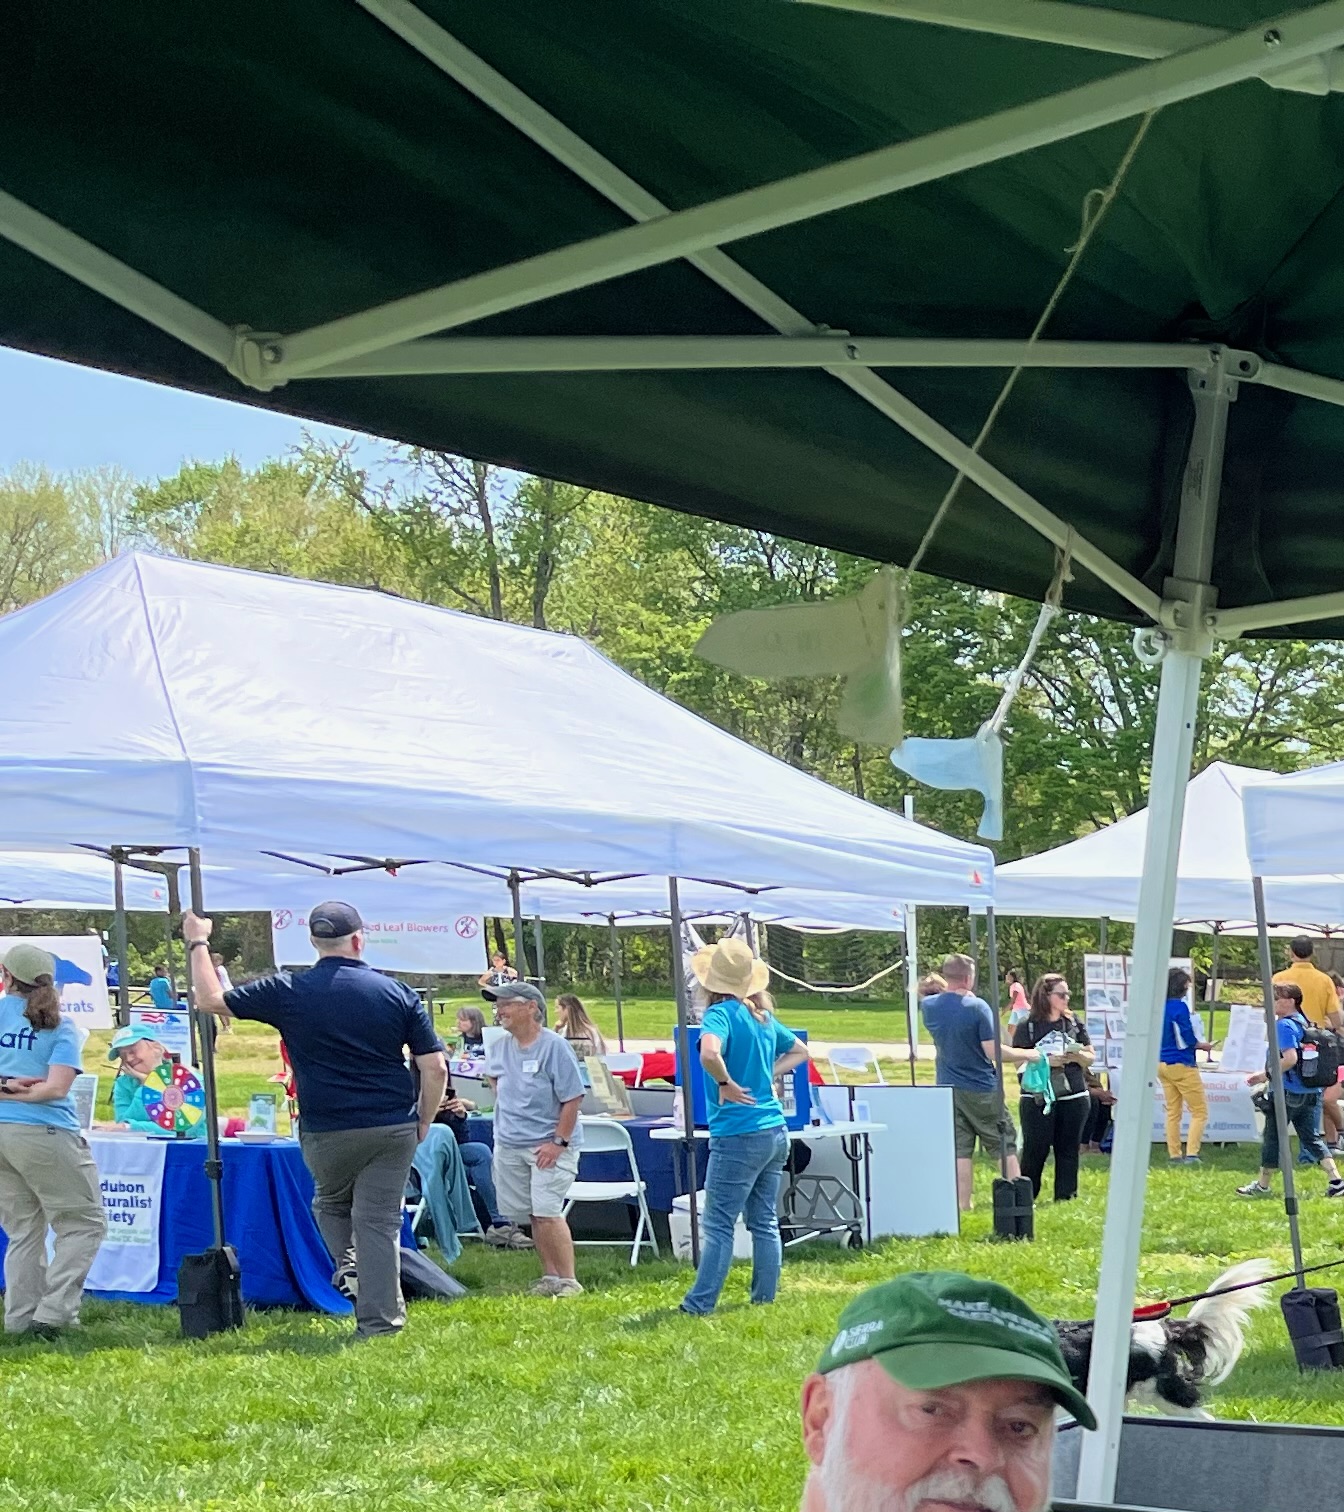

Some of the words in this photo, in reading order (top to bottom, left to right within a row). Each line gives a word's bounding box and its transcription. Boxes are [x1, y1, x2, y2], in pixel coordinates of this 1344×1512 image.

[384, 922, 404, 932] Leaf
[407, 923, 448, 933] Blowers
[59, 1000, 94, 1013] crats
[0, 1027, 38, 1051] aff
[100, 1180, 145, 1193] dubon
[102, 1196, 152, 1208] turalist
[108, 1209, 136, 1225] iety
